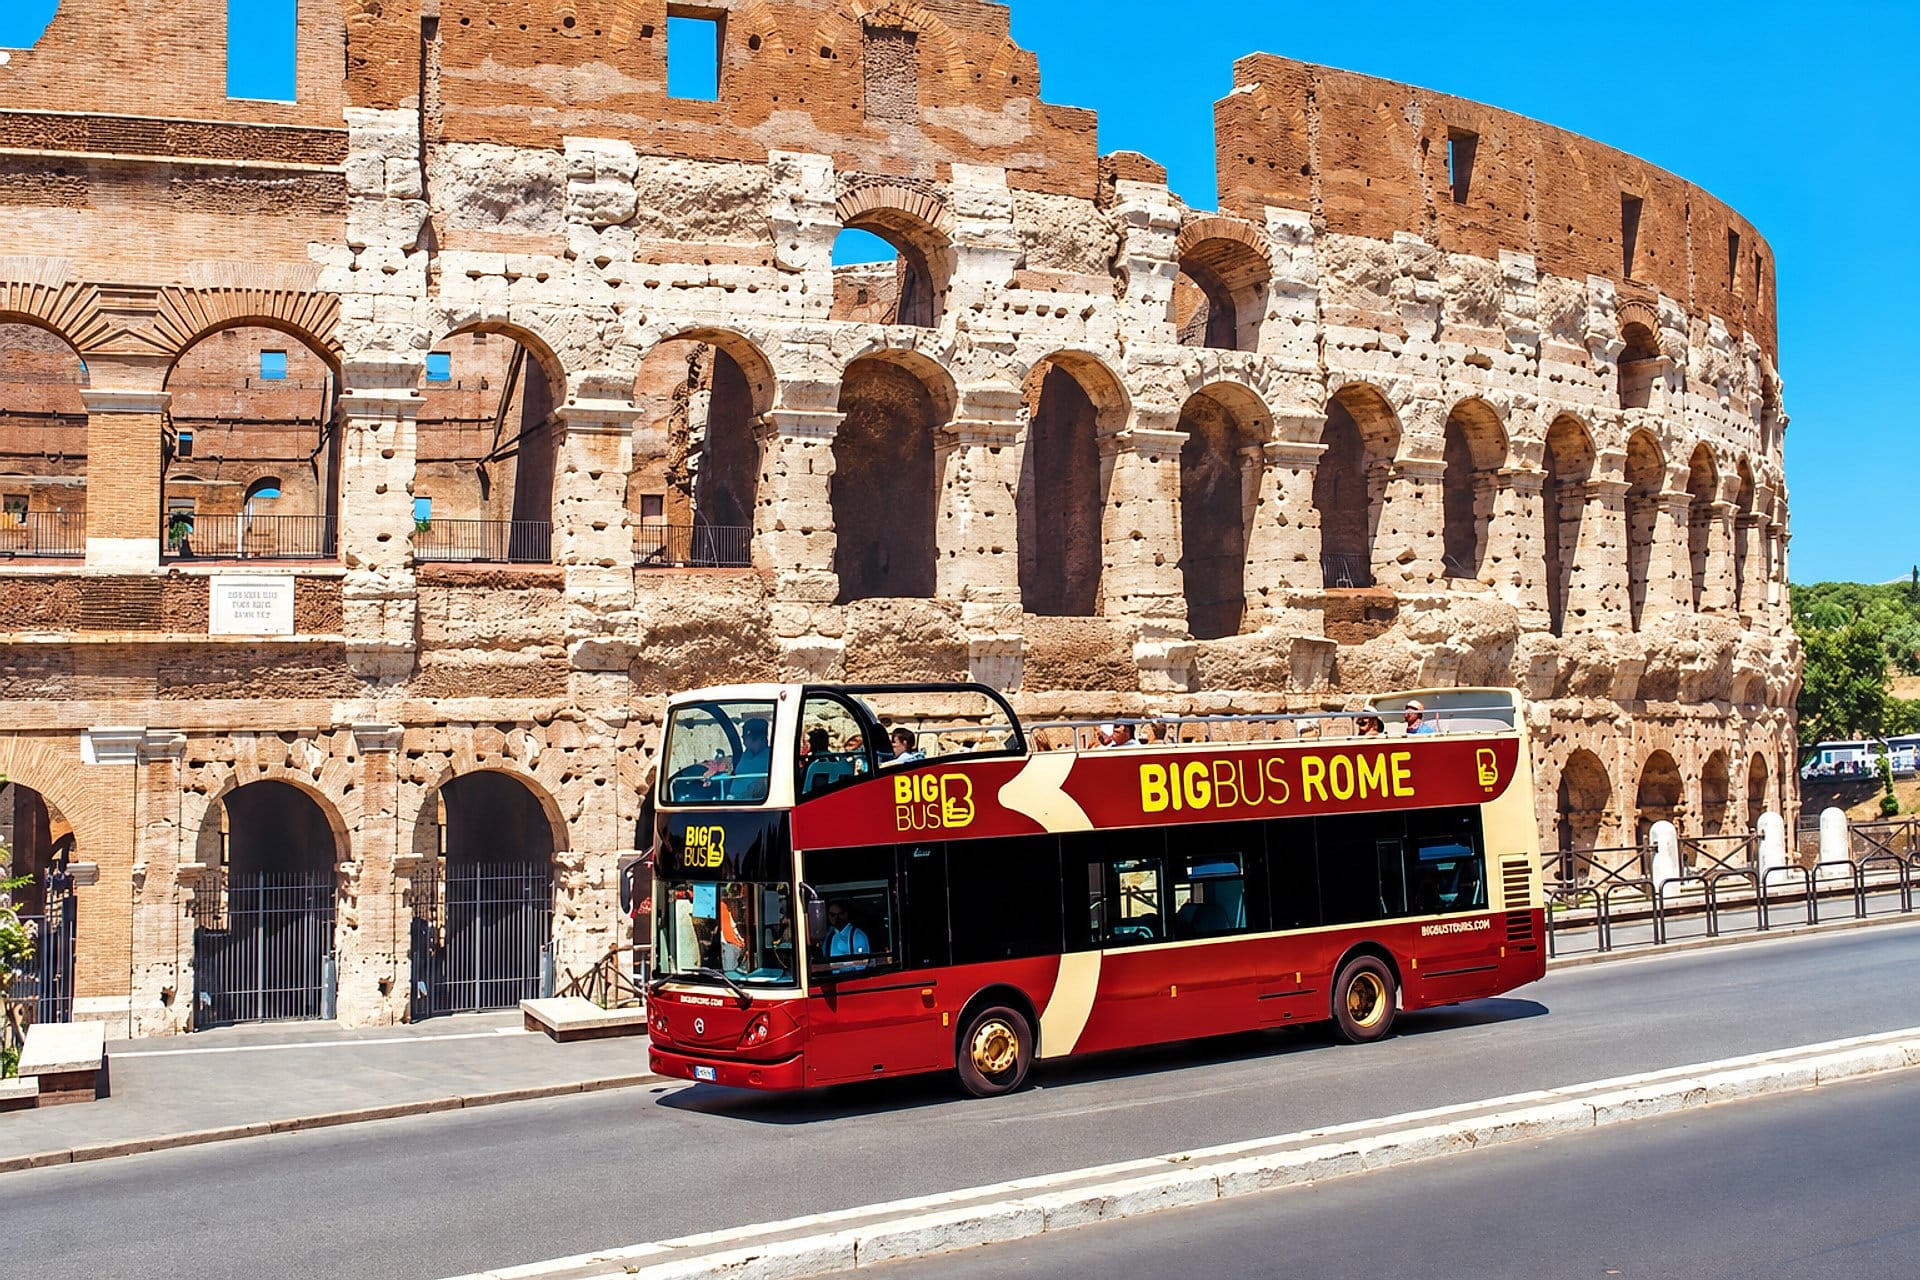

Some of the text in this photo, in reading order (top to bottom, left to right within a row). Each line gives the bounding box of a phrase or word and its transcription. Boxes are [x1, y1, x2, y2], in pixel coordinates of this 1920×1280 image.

[1301, 751, 1415, 802] ROME
[894, 774, 939, 804] BIG
[896, 803, 942, 831] BUS
[685, 826, 708, 846] BIG
[684, 847, 707, 867] BUS
[1421, 919, 1491, 936] BIGBUSTOURS.COM
